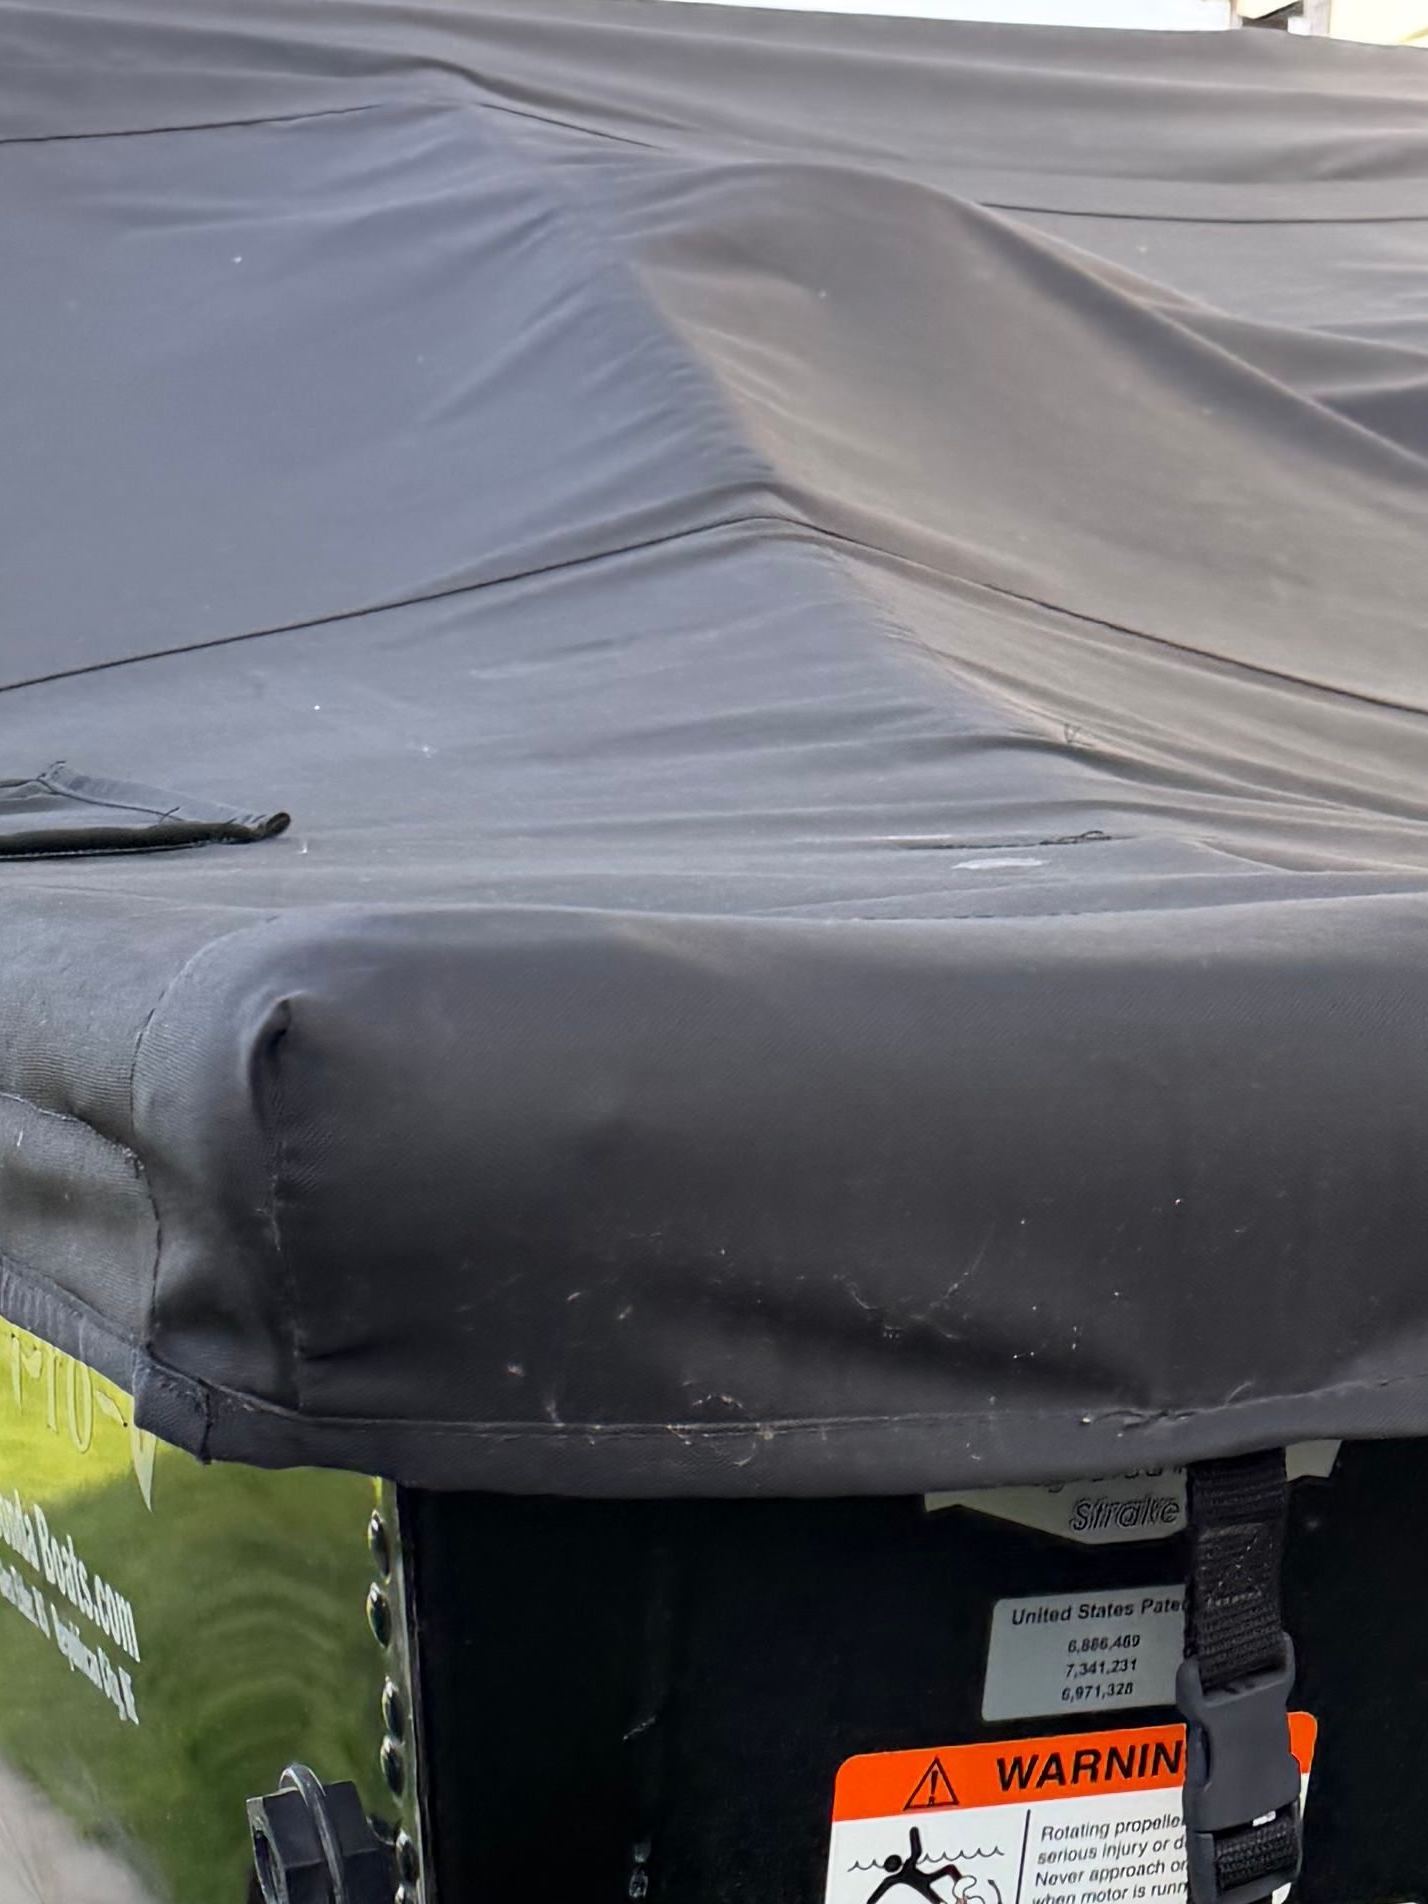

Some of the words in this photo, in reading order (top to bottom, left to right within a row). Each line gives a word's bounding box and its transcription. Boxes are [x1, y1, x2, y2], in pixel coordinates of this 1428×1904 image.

[1070, 1497, 1181, 1532] Strake
[34, 1503, 141, 1663] Boats.com
[1012, 1604, 1071, 1626] United
[1078, 1601, 1134, 1620] States
[1141, 1598, 1186, 1615] Pate
[996, 1740, 1184, 1792] WARNIN
[1041, 1820, 1110, 1843] Rotating
[1115, 1813, 1184, 1836] propelle
[1037, 1845, 1098, 1865] serious
[1102, 1838, 1148, 1860] injury
[1152, 1839, 1170, 1853] or
[1035, 1868, 1084, 1887] Never
[1089, 1858, 1166, 1883] approach
[1081, 1884, 1127, 1904] motor
[1132, 1883, 1146, 1899] is
[1151, 1880, 1188, 1898] runn
